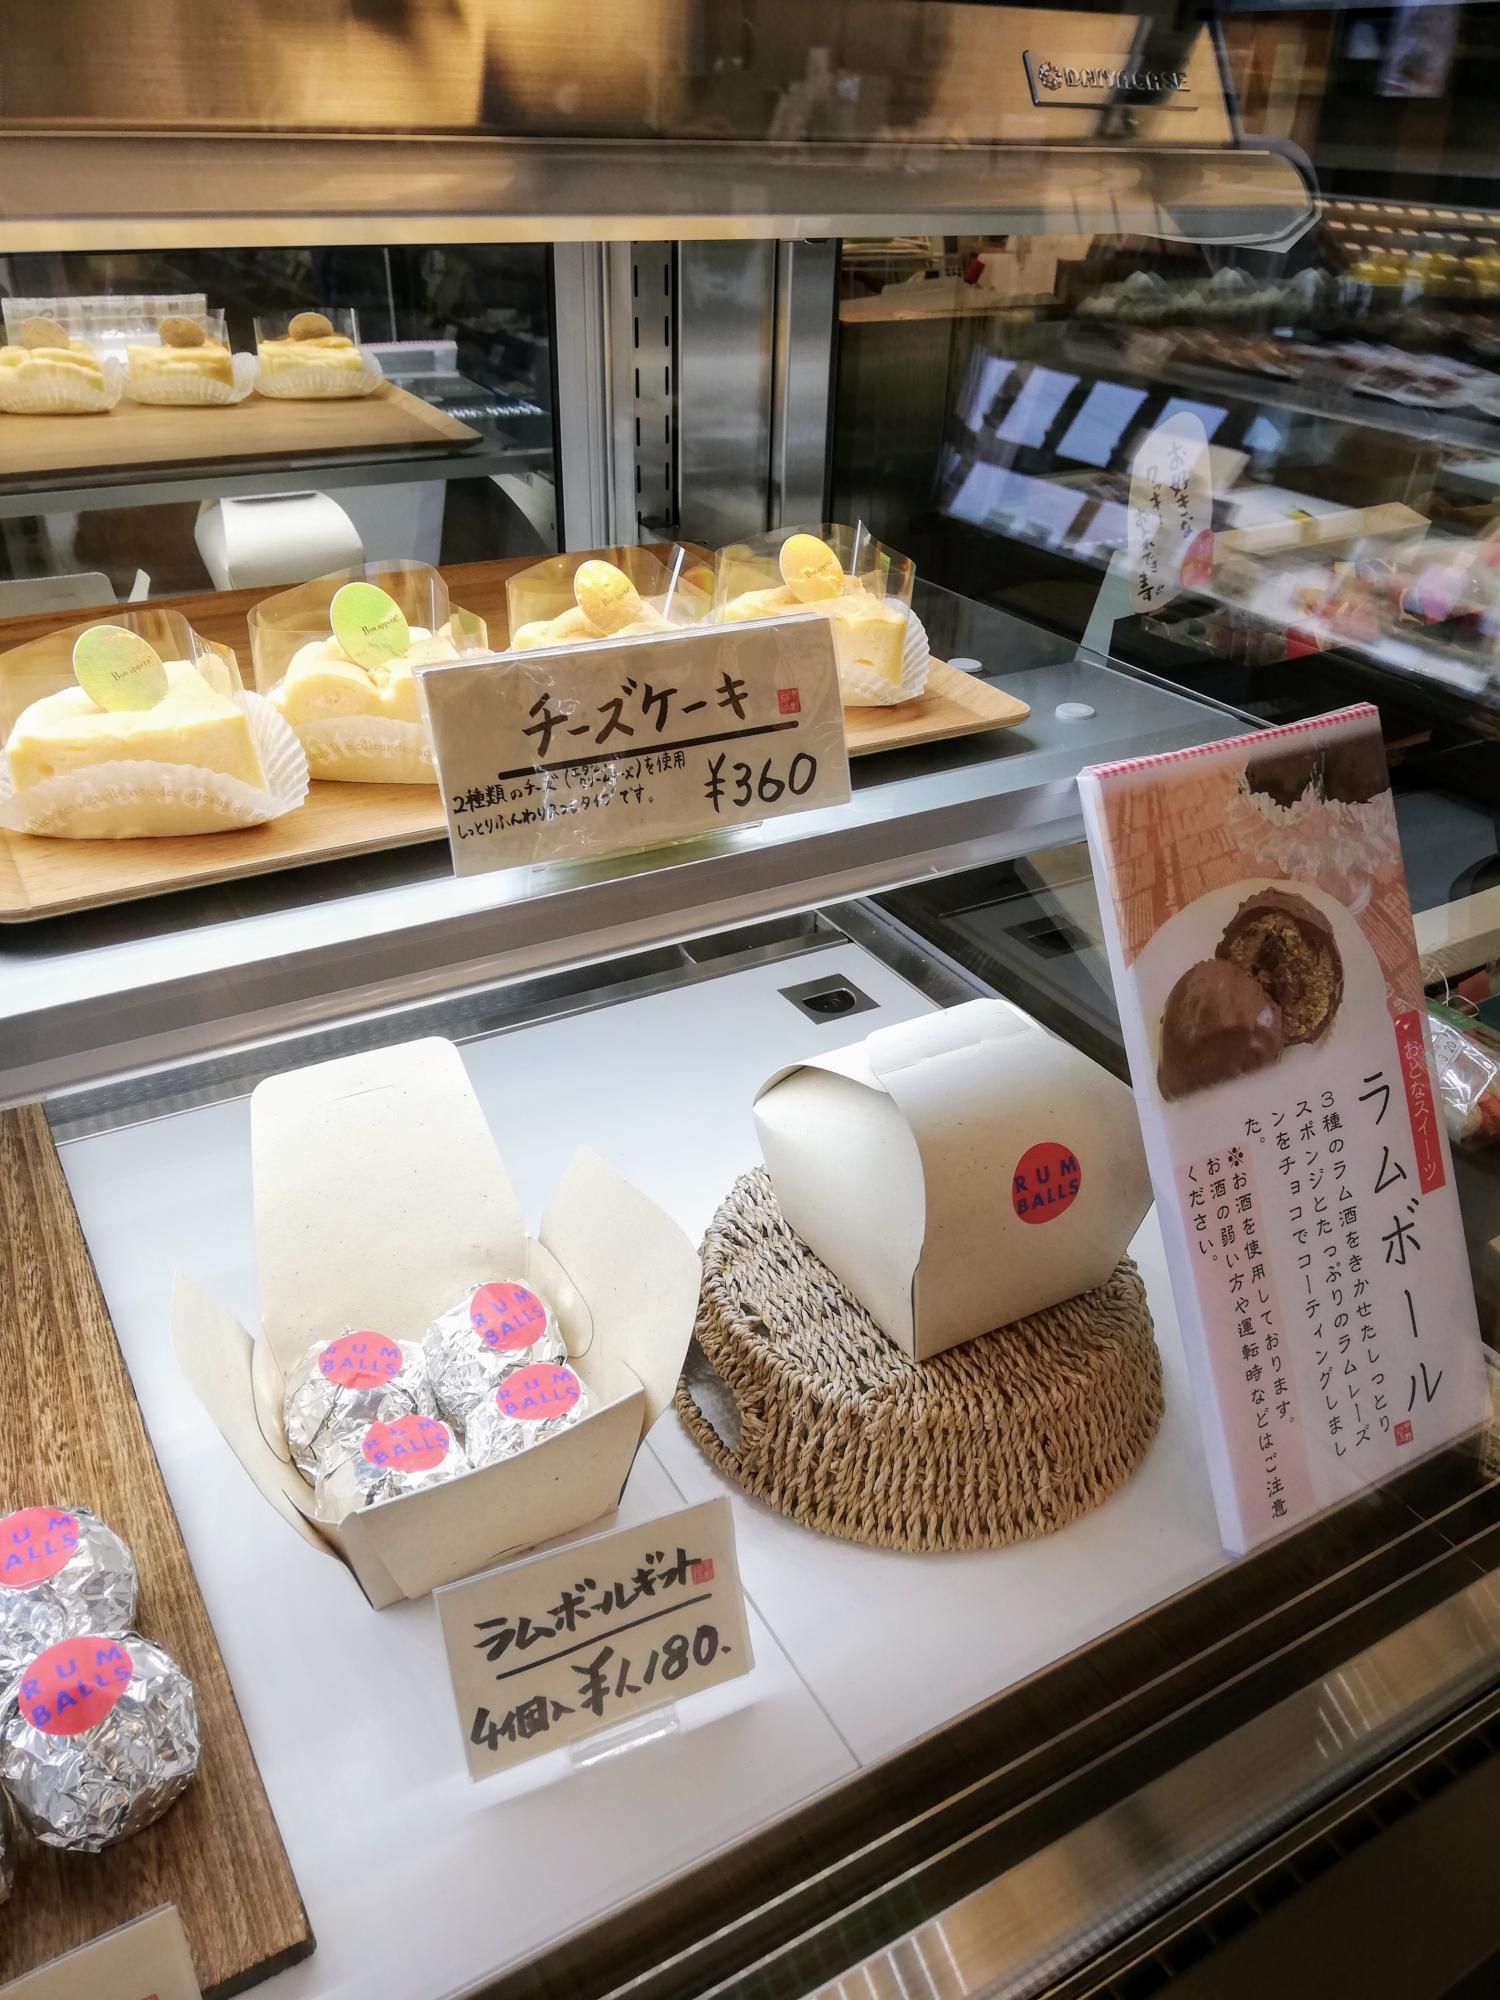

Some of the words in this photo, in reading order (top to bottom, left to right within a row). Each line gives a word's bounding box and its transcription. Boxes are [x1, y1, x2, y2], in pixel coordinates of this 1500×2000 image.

[522, 671, 752, 758] チーズケーキ
[703, 751, 818, 813] ¥360
[1244, 1117, 1266, 1144] た。
[1403, 1040, 1437, 1182] おとなスイーツ
[1014, 1156, 1077, 1193] RUM
[1017, 1178, 1079, 1216] BALLS
[1187, 1165, 1218, 1262] ください。
[1321, 1091, 1390, 1433] 3種のラム酒をきかせたしっとり
[1358, 1071, 1443, 1412] ラムボール
[1271, 1111, 1347, 1457] ンをチョコでコーティングしまし
[1296, 1100, 1371, 1447] スポンジとたっぷりのラムレーズ
[472, 1288, 533, 1327] RUM
[485, 1305, 545, 1345] BALLS
[1206, 1157, 1288, 1520] お酒の弱い方や運転時などはご注意
[321, 1358, 397, 1376] BALLS
[500, 1369, 572, 1401] RUM
[503, 1386, 581, 1414] BALLS
[374, 1431, 450, 1465] BALLS
[4, 1531, 79, 1571] ALLS
[11, 1515, 73, 1545] UM
[21, 1646, 122, 1701] RUM
[31, 1665, 130, 1727] BALLS
